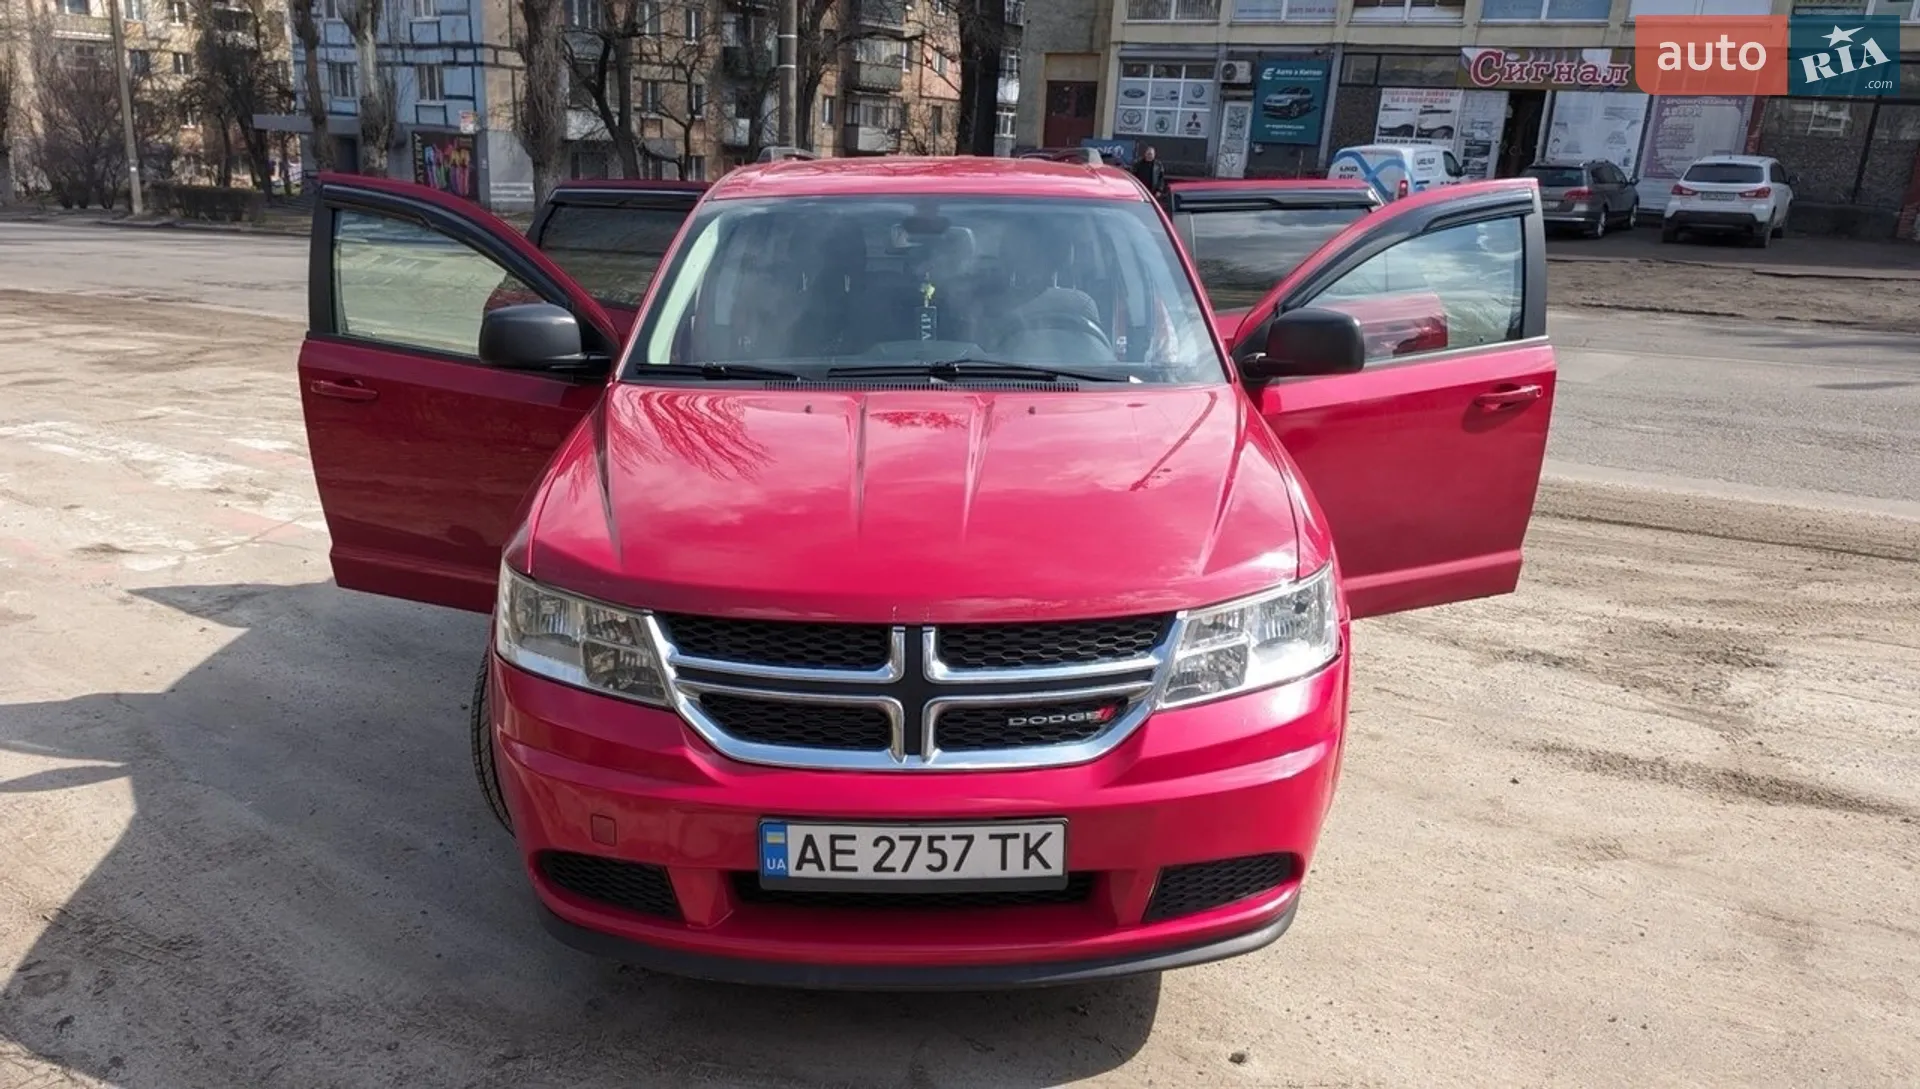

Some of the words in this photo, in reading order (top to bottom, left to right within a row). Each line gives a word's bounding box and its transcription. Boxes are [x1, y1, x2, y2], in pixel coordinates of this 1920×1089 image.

[1470, 49, 1631, 87] Сигнал
[921, 313, 932, 341] VIP
[1008, 711, 1099, 726] DODGE
[766, 857, 786, 871] UA
[795, 833, 858, 872] AE
[872, 834, 975, 873] 2757
[988, 832, 1053, 871] TK
